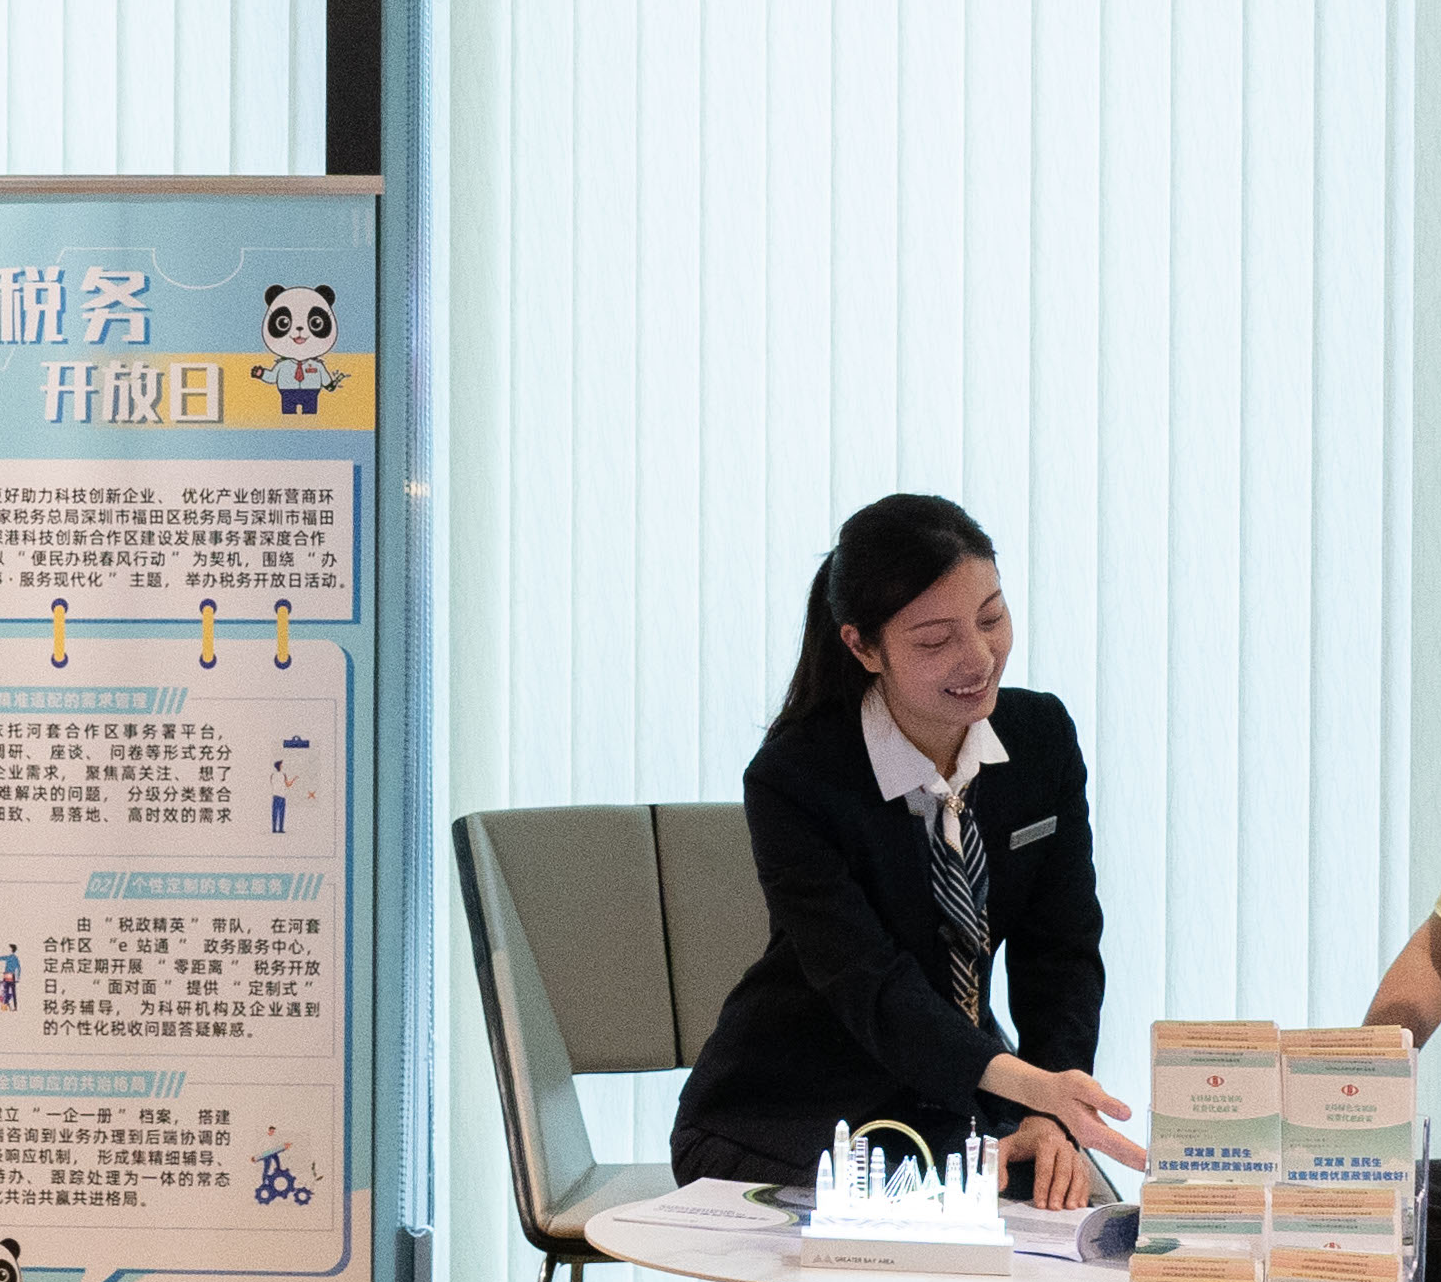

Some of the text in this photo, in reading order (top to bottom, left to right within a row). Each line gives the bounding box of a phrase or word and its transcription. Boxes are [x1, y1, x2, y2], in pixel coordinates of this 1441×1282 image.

[40, 360, 223, 424] 开放日
[88, 877, 283, 895] 02 个性定制的专业服务
[42, 1020, 255, 1039] 的个性化税收问题答疑解惑。
